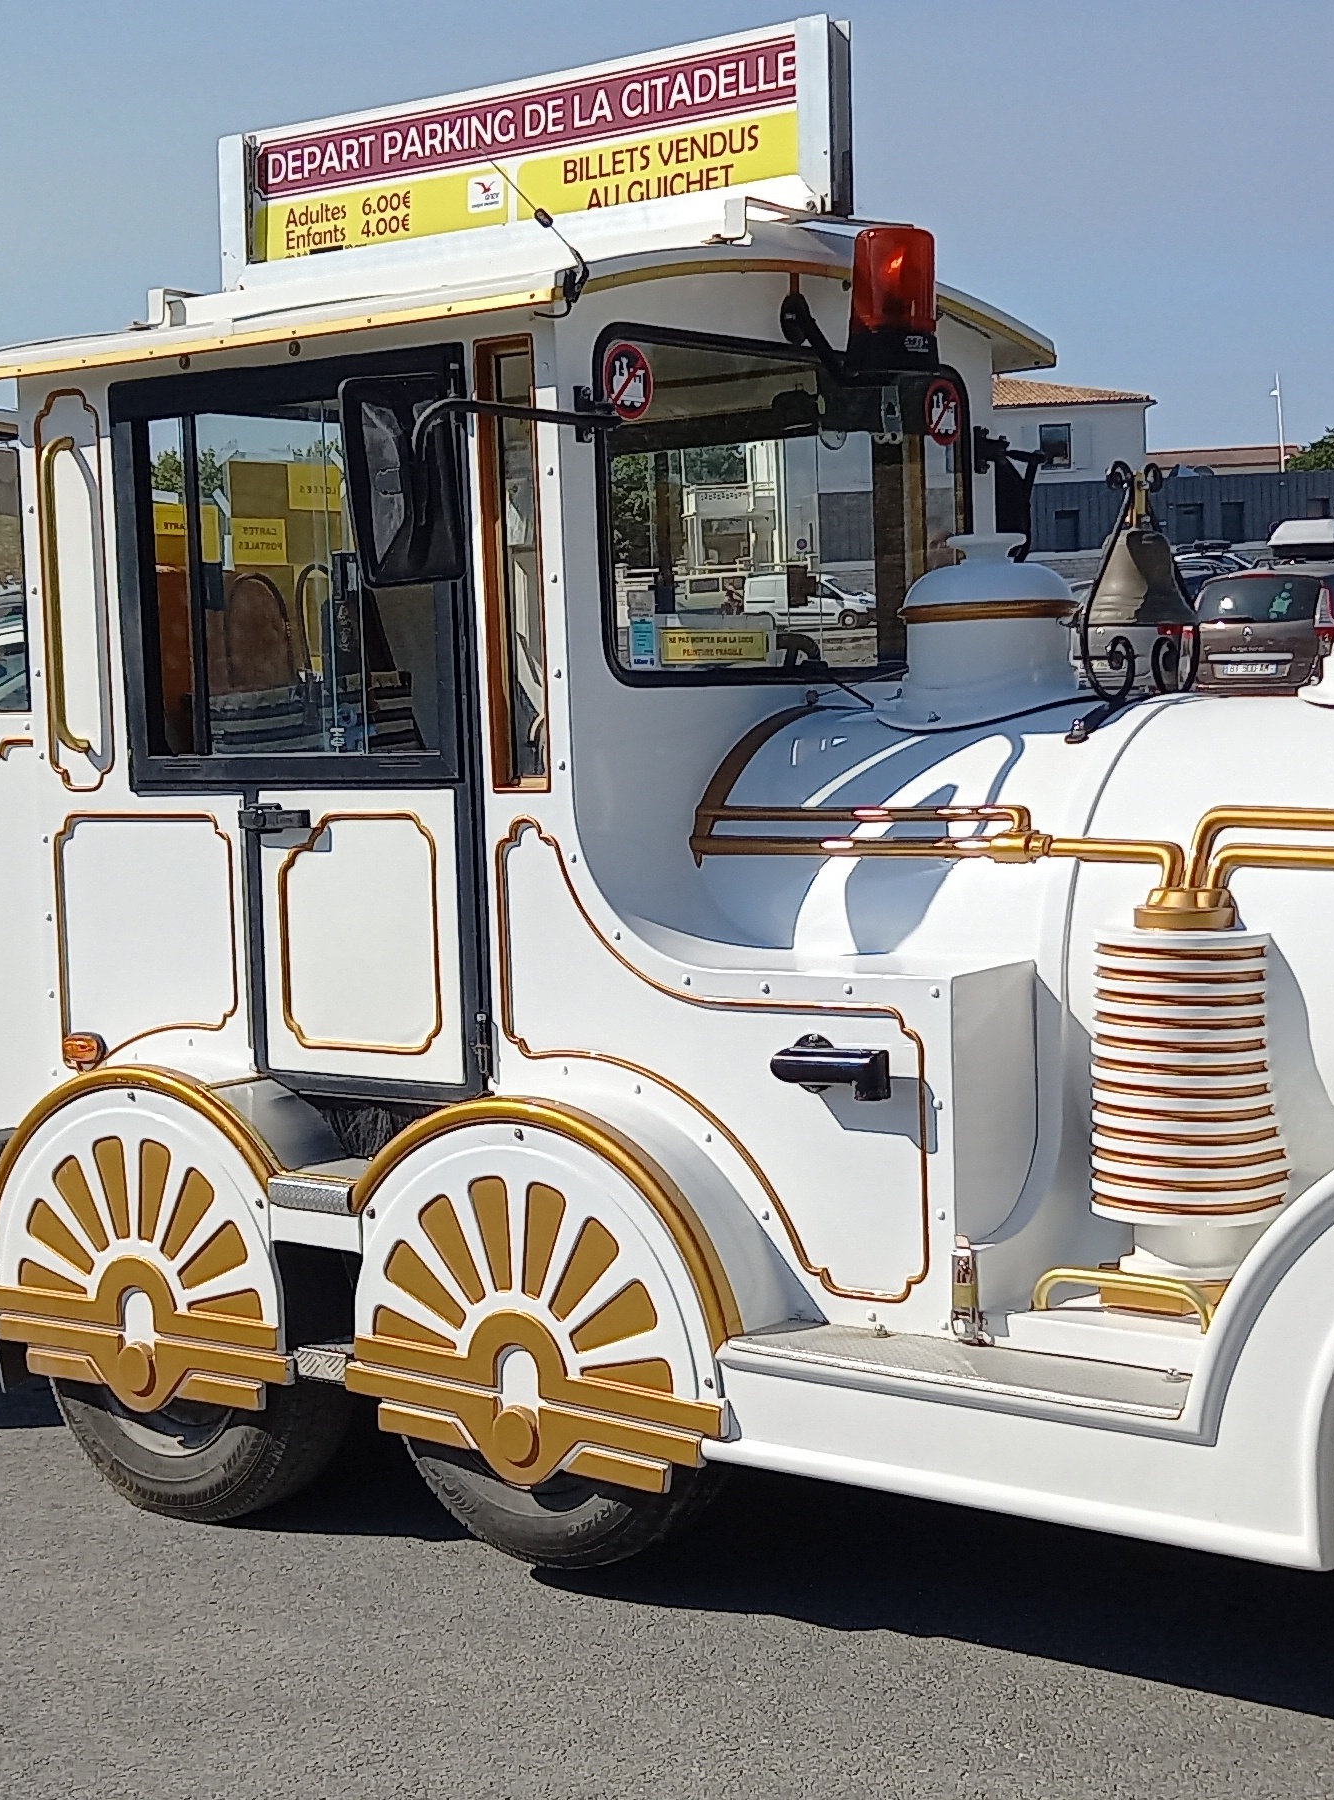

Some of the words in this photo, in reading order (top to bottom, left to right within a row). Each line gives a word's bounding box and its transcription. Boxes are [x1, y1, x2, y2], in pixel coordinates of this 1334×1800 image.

[267, 134, 377, 185] DEPART
[383, 109, 515, 164] PARKING
[524, 97, 565, 138] DE
[573, 88, 614, 129] LA
[621, 50, 796, 118] CITADELLE
[563, 145, 651, 184] BILLETS
[658, 125, 759, 166] VENDUS
[285, 203, 347, 228] Adultes
[362, 190, 411, 215] 6.00€
[587, 184, 620, 210] AU
[627, 164, 734, 203] GUICHET
[286, 224, 346, 250] Enfants
[361, 213, 410, 238] 4.00€
